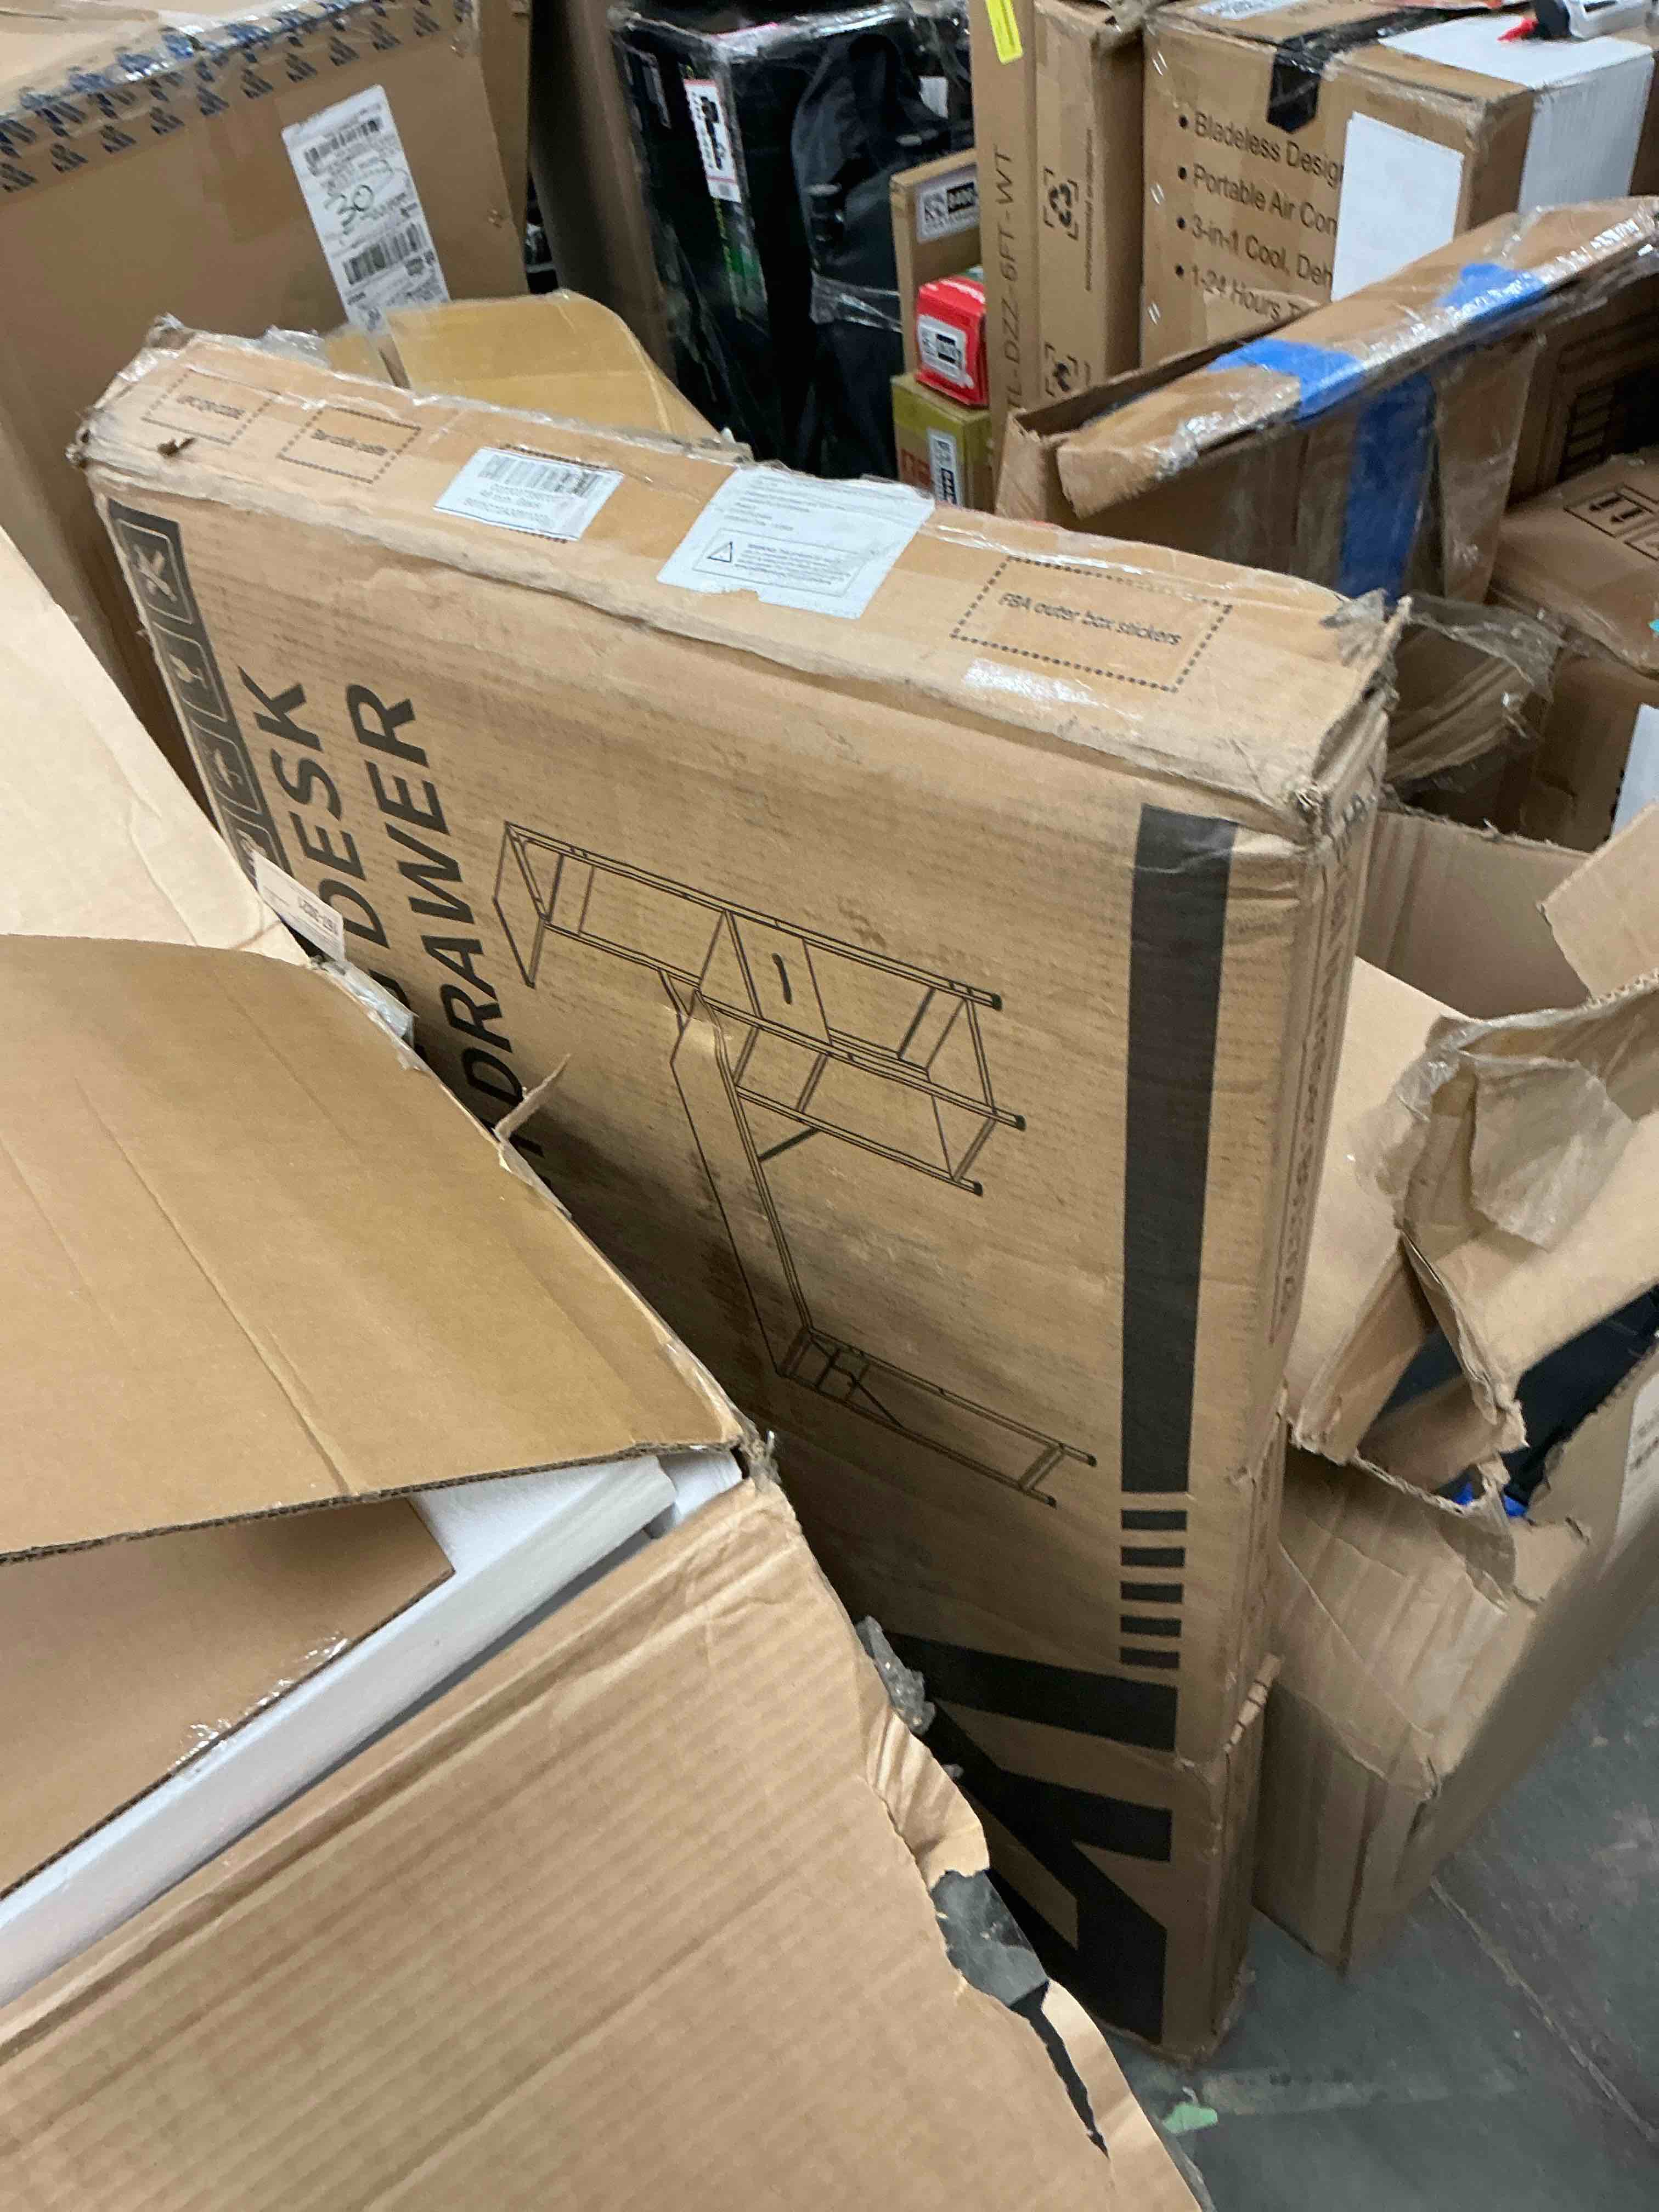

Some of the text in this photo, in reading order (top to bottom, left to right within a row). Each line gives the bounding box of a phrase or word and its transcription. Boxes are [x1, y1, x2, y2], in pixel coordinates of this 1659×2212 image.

[1194, 111, 1281, 162] Bladeless
[1193, 163, 1266, 212] Portable
[1269, 191, 1295, 220] Air
[1192, 213, 1238, 255] 3-in-1
[1231, 276, 1281, 322] Hours
[236, 664, 390, 949] DESK
[346, 679, 524, 1107] DRAWER
